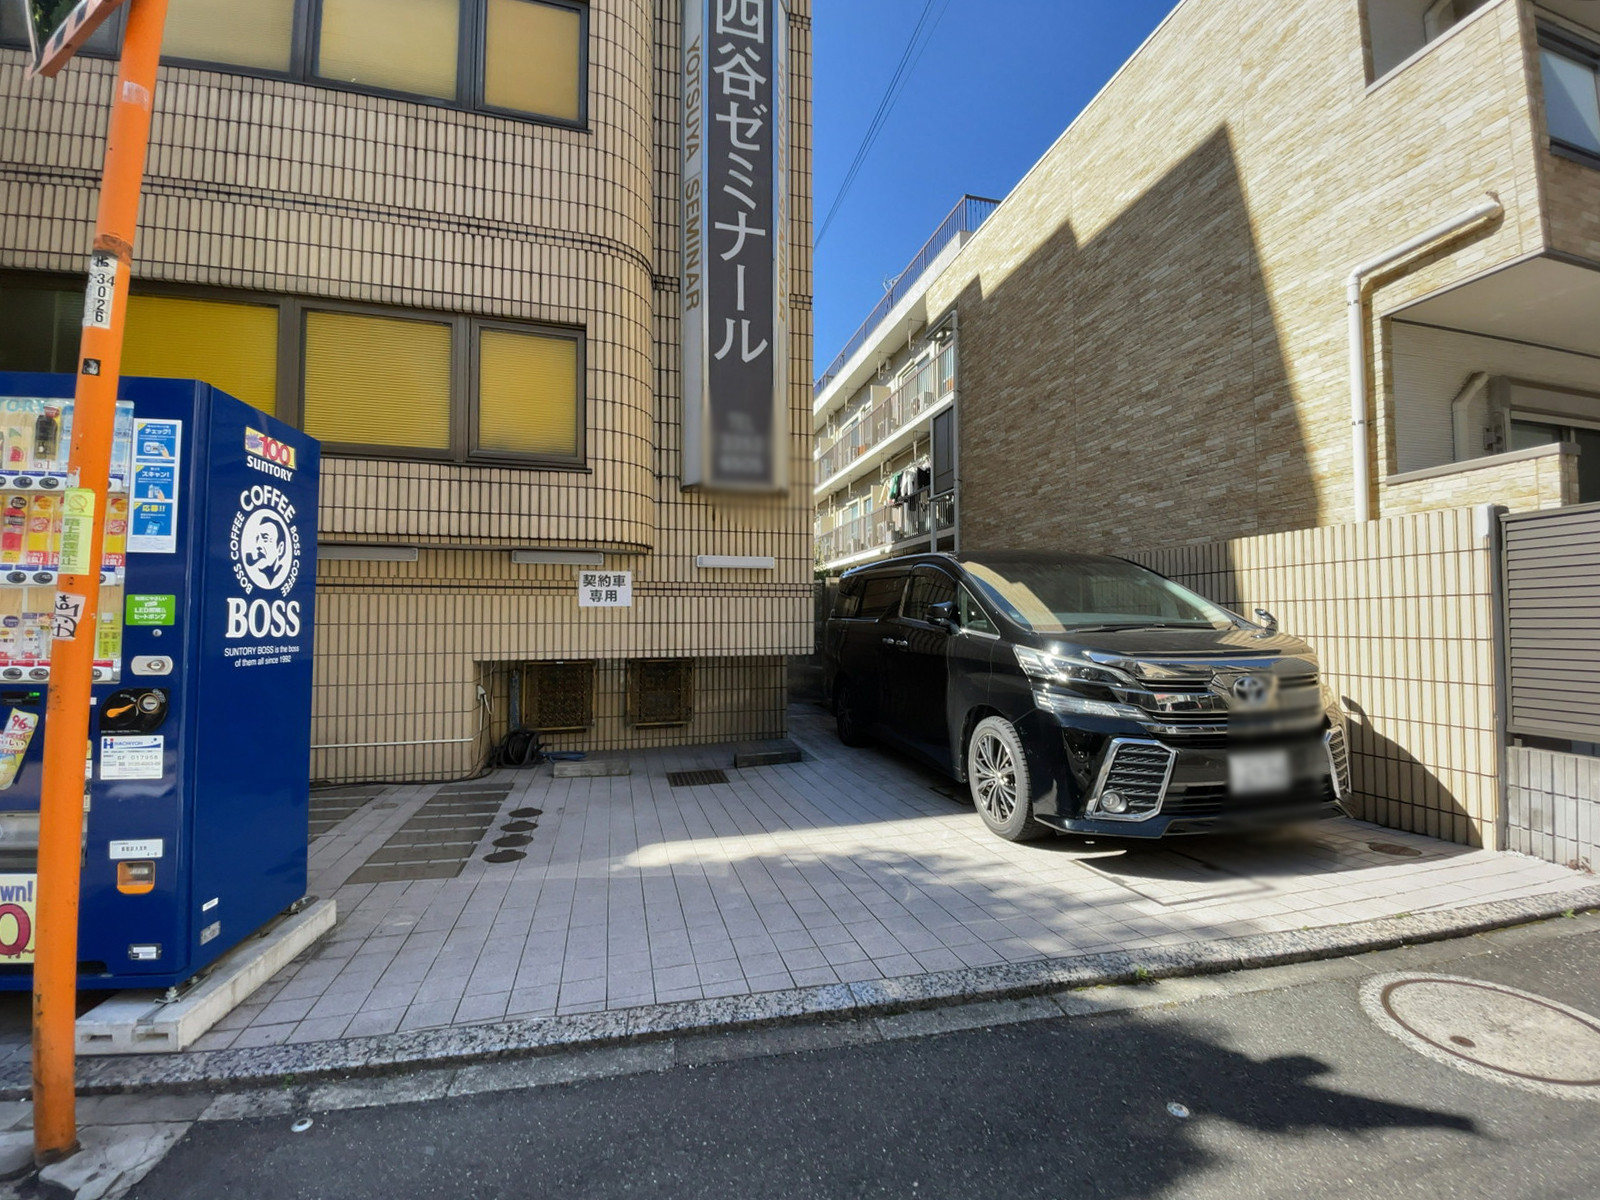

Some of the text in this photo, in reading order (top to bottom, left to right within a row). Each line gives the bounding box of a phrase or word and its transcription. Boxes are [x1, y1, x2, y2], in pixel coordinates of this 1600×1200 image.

[686, 34, 700, 312] YOTSUYA SEMINAR
[712, 0, 769, 364] 四谷ゼミナール
[259, 436, 291, 466] 100
[246, 455, 293, 482] SUNTORY
[240, 485, 297, 524] COFFEE
[230, 510, 254, 596] BOSS COFFEE
[280, 525, 301, 598] BOSS COFFEE
[583, 574, 626, 588] 契約車
[589, 589, 618, 603] 専用
[225, 597, 300, 638] BOSS
[224, 646, 257, 657] SUNTORY
[257, 645, 274, 655] BOSS
[280, 645, 288, 653] the
[288, 645, 300, 653] boss
[235, 659, 241, 668] of
[242, 658, 257, 667] them
[265, 656, 279, 665] since
